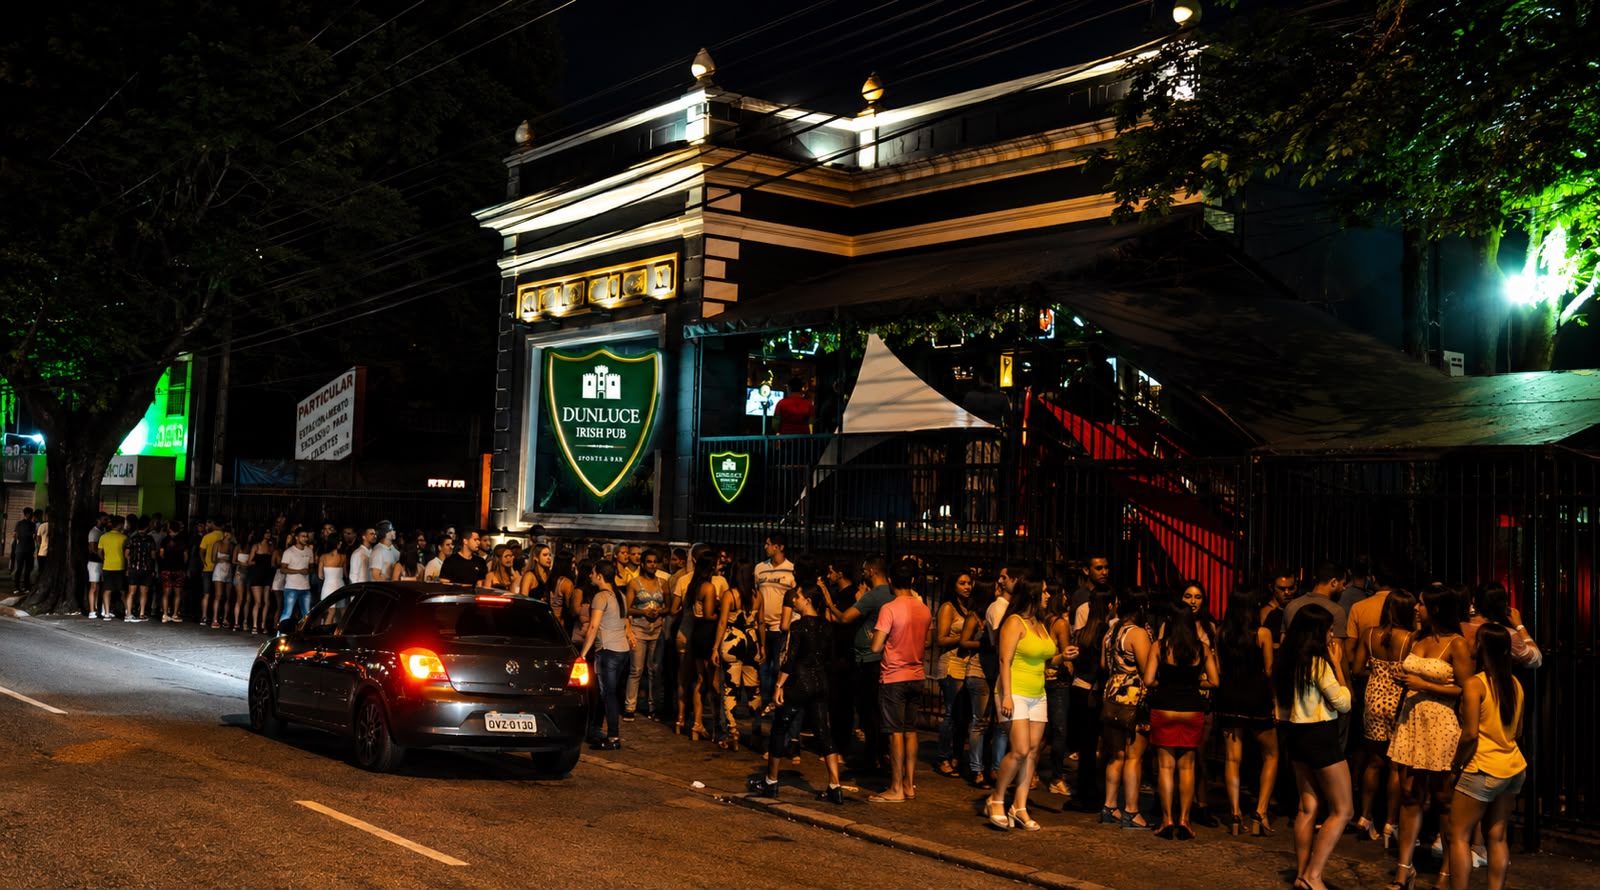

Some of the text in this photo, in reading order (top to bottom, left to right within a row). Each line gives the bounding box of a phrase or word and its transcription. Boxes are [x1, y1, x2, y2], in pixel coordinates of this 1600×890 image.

[298, 374, 353, 421] PARTICULAR
[562, 406, 641, 424] DUNLUCE
[576, 427, 627, 439] IRISH PUB
